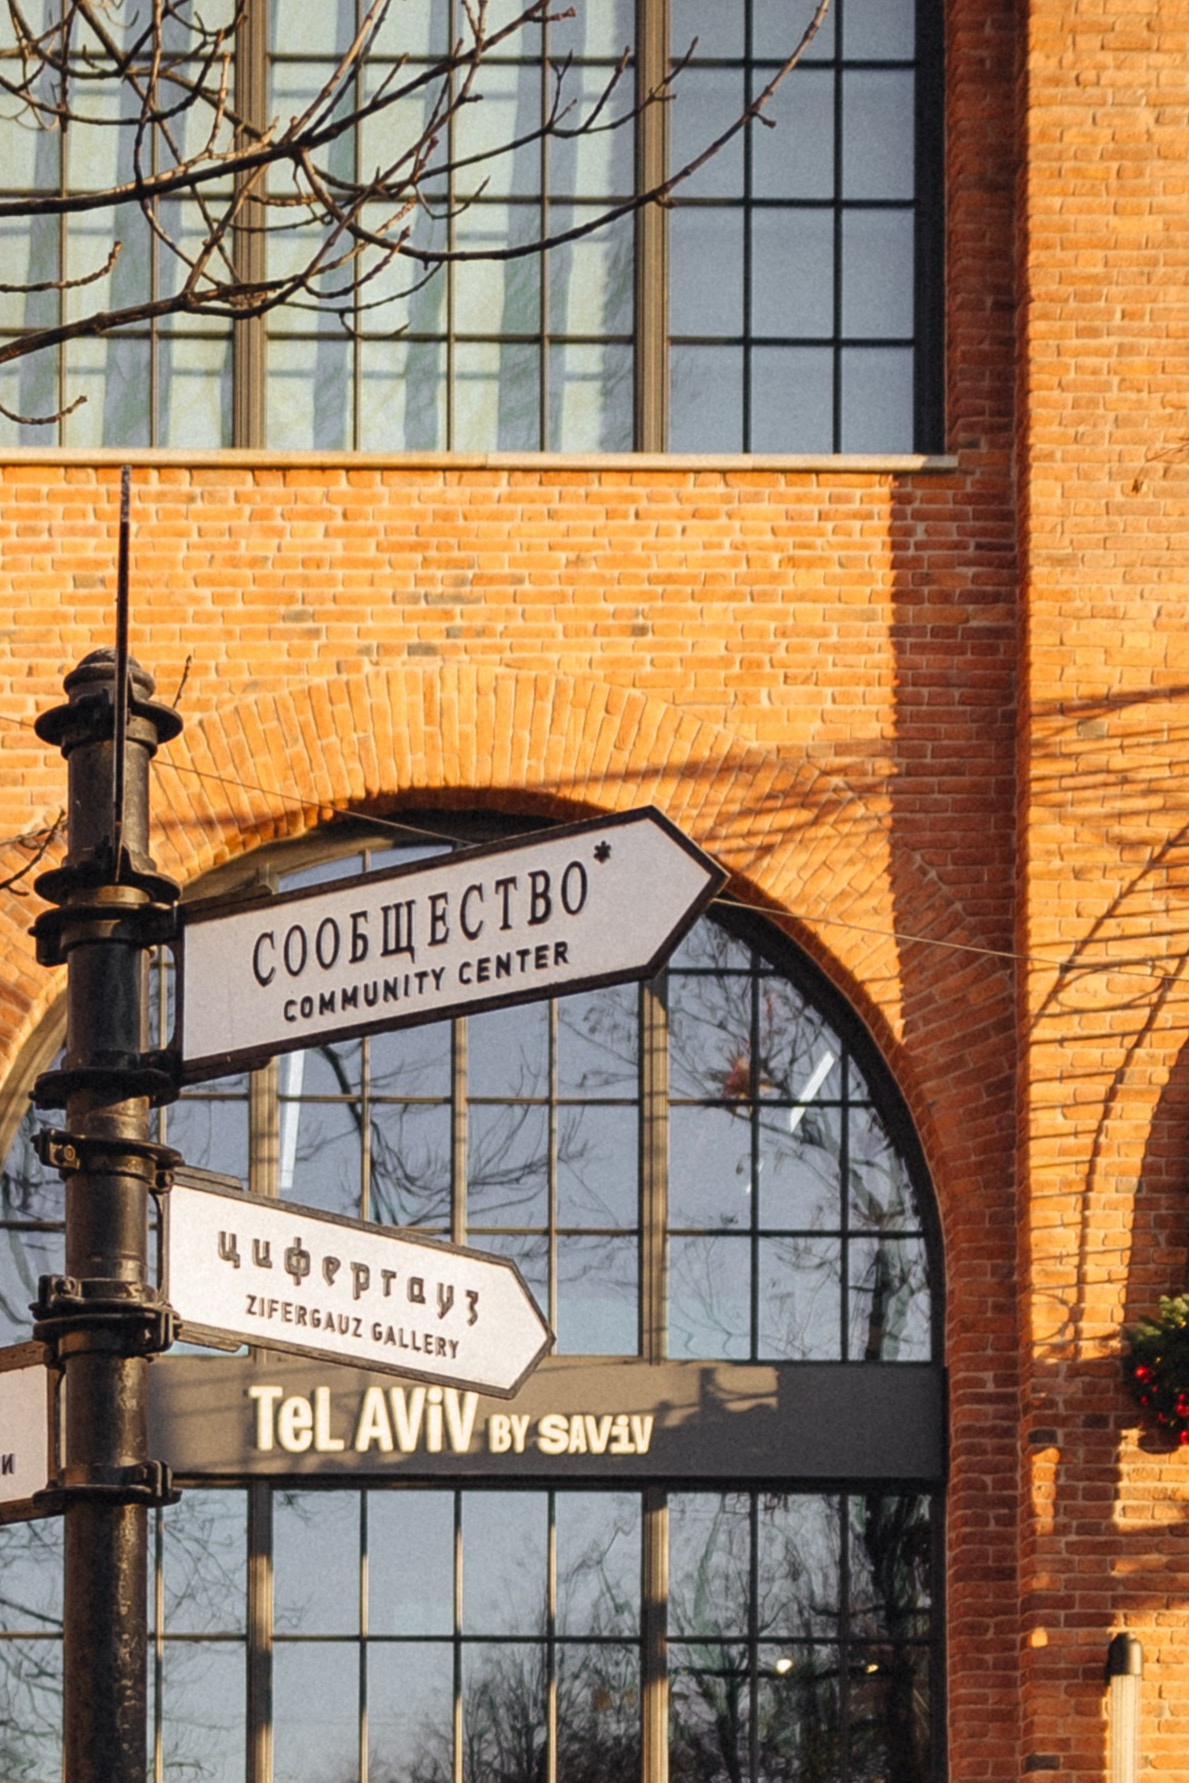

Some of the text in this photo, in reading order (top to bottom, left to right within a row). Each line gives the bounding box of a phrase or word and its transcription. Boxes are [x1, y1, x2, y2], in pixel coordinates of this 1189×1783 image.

[283, 941, 570, 1023] COMMUNITY CENTER
[245, 1293, 460, 1360] ZIFERGAUZ GALLERY
[488, 1413, 531, 1454] BY
